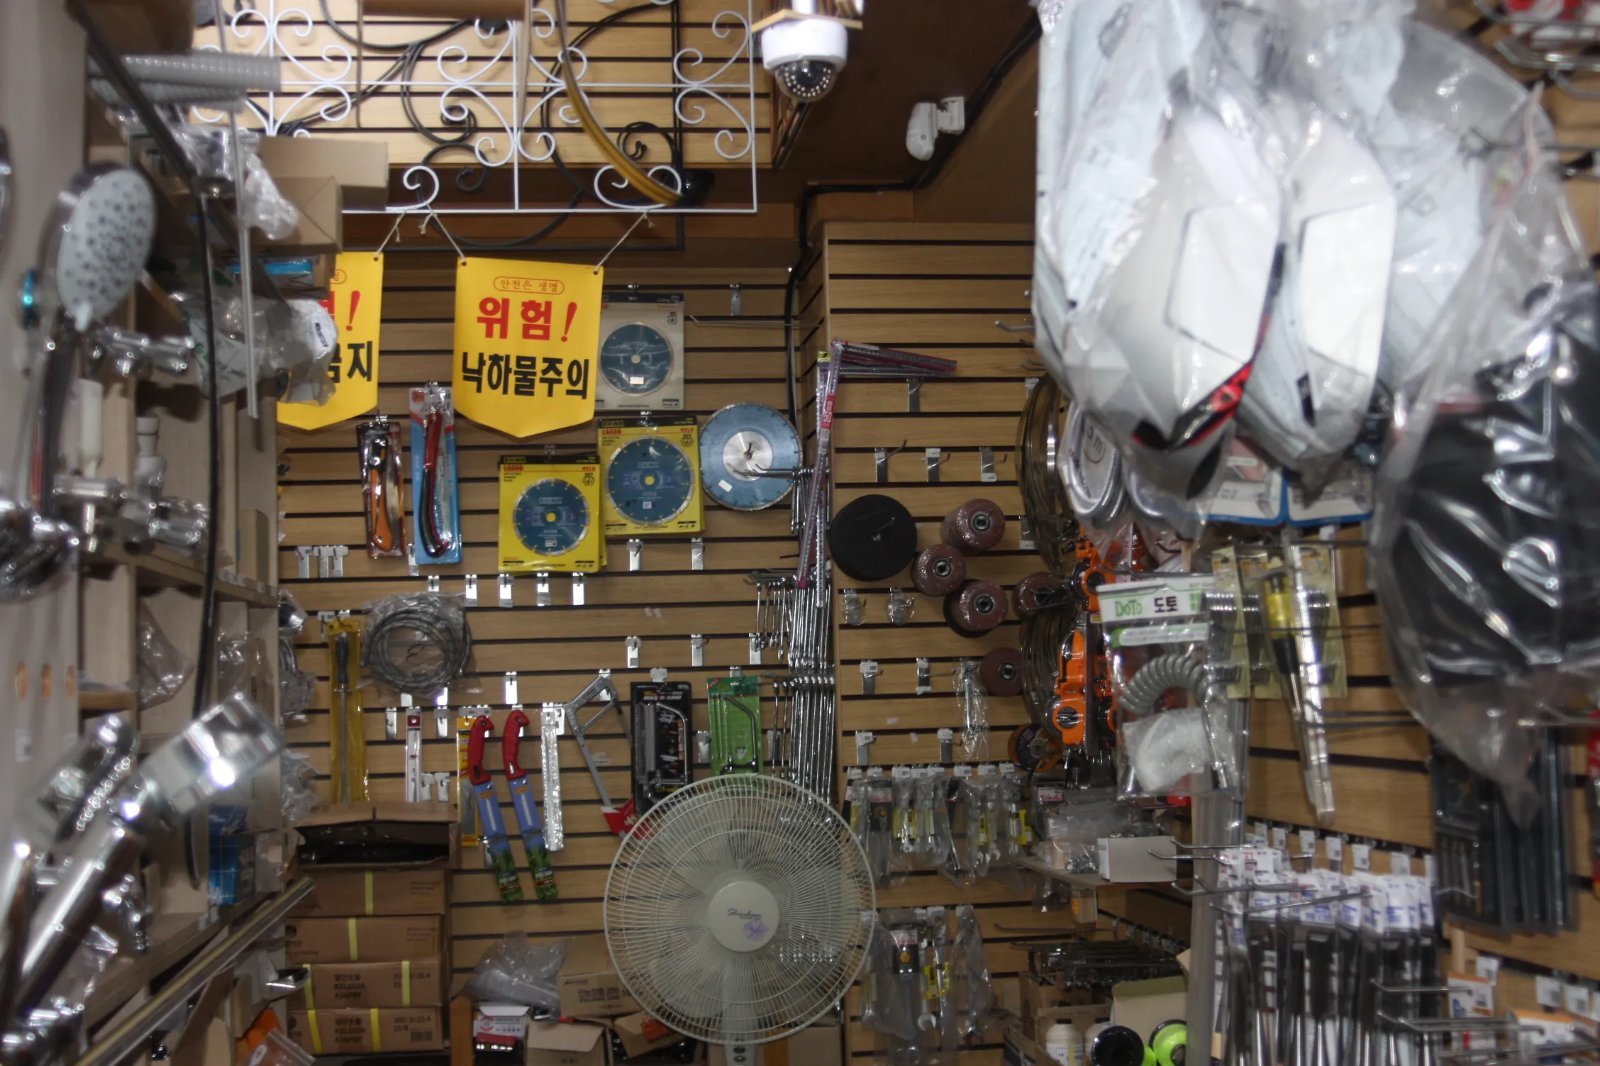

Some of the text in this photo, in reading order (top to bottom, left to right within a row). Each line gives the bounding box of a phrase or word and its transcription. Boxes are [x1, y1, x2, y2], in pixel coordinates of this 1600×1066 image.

[500, 279, 559, 293] 안전은 생명
[476, 296, 578, 343] 위험!
[461, 351, 590, 400] 낙하물주의
[1153, 596, 1179, 614] 도토
